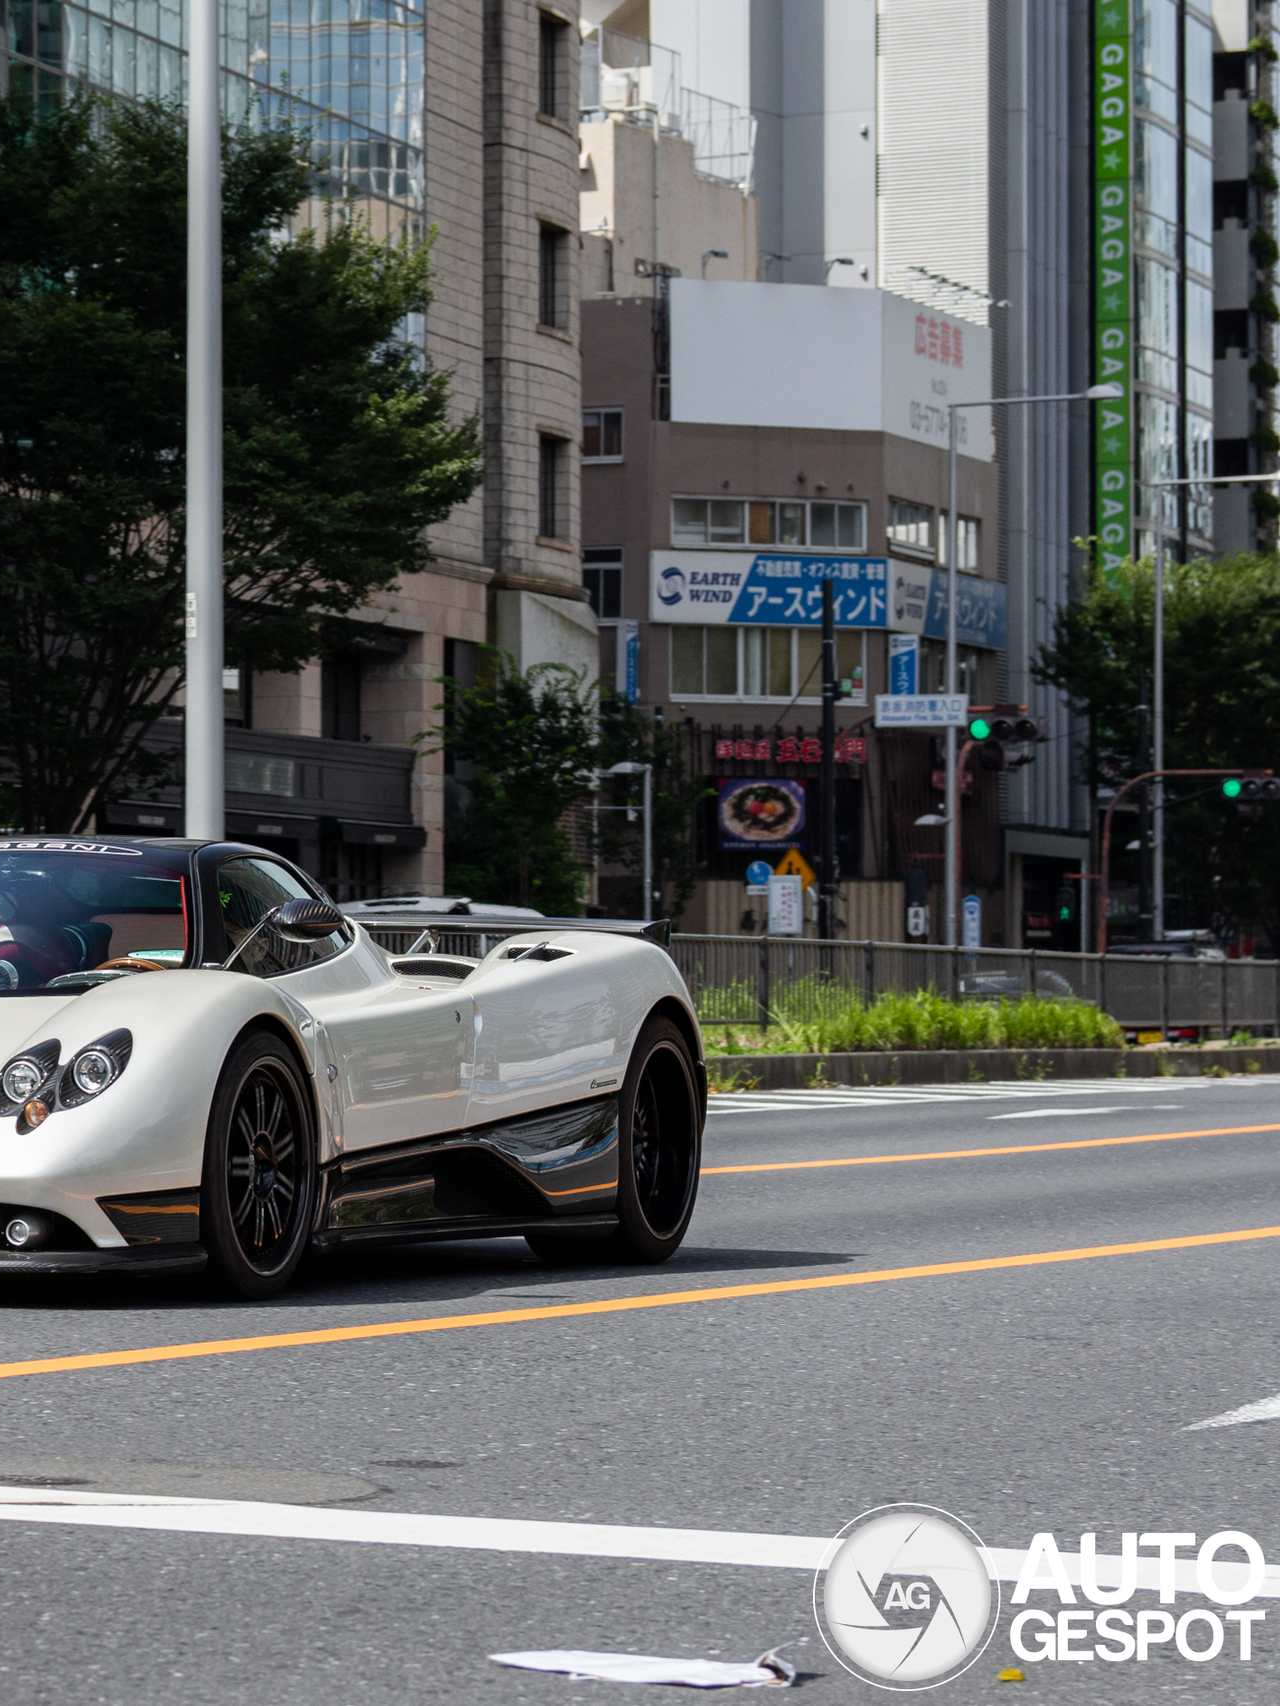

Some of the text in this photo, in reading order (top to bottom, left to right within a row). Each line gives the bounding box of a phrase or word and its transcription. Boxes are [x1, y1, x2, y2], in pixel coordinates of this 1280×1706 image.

[1101, 43, 1125, 146] GAGA
[1101, 186, 1125, 288] GAGA
[915, 312, 963, 368] 広告募集
[1101, 470, 1125, 572] GAGA
[689, 572, 741, 586] EARTH
[689, 590, 733, 603] WIND
